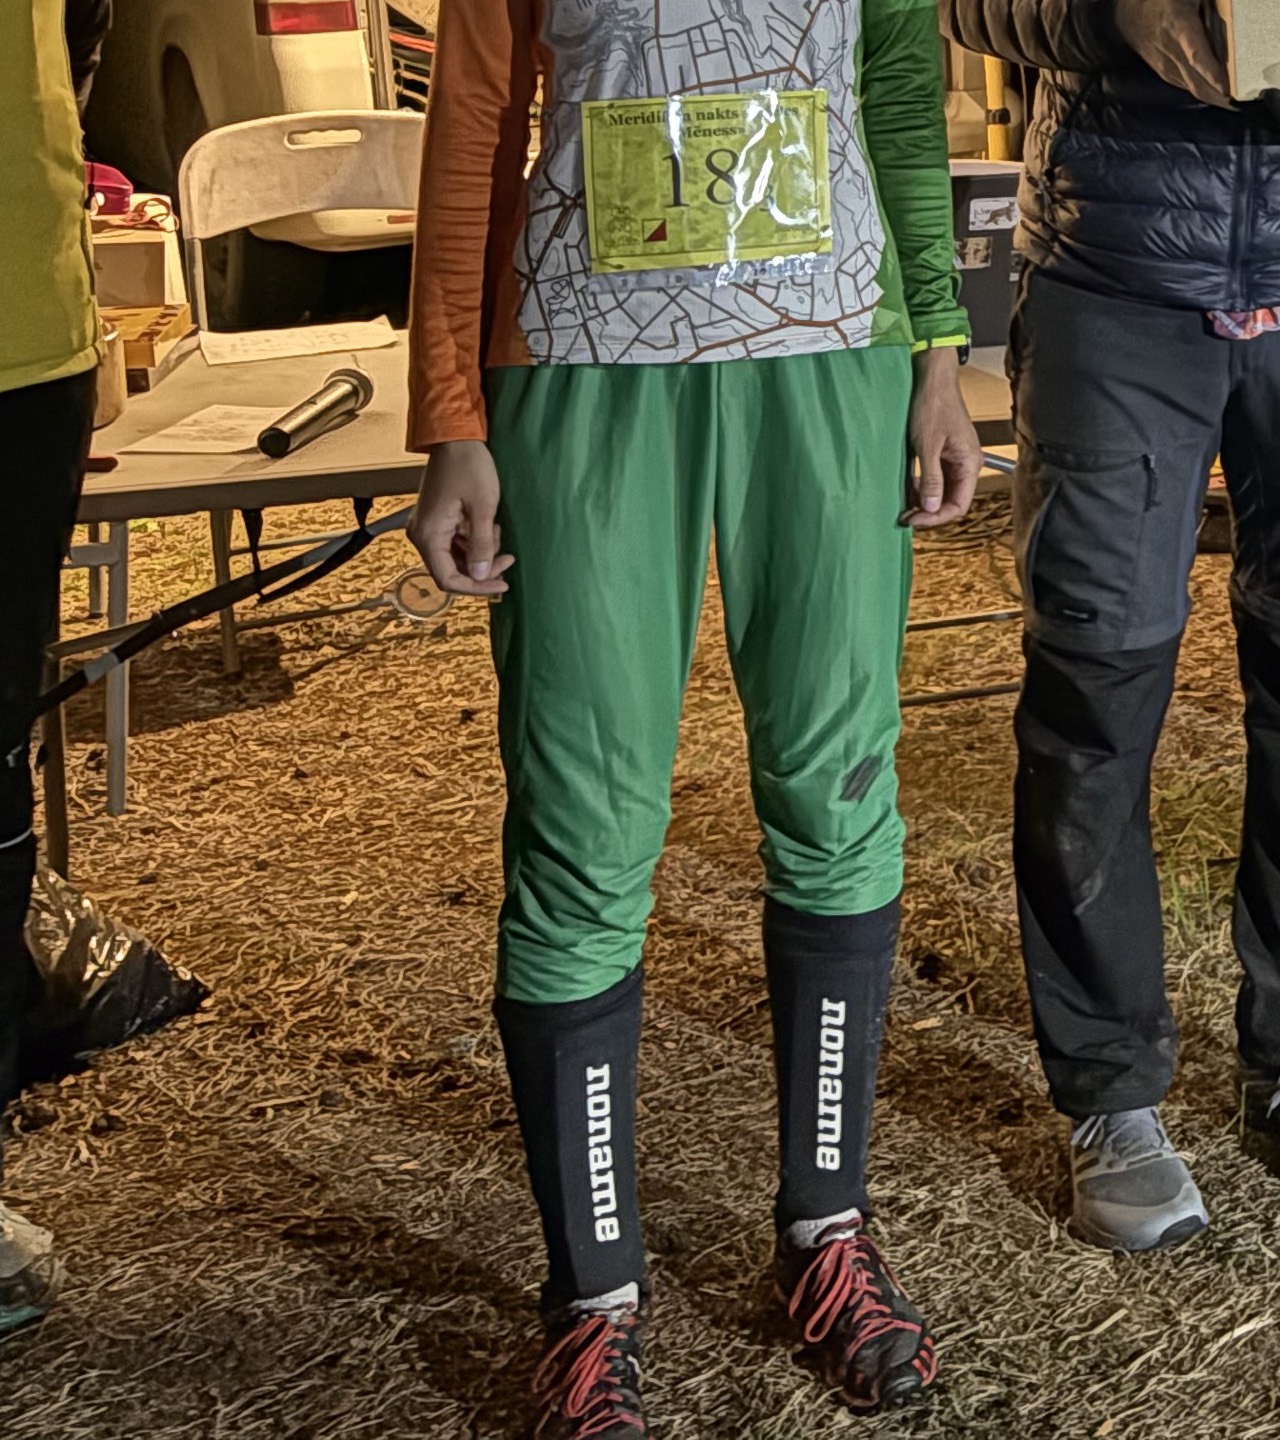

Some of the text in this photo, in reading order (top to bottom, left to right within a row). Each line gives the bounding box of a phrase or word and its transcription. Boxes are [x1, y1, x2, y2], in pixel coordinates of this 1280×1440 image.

[696, 107, 739, 121] nakts
[586, 1063, 620, 1242] noname
[816, 997, 846, 1171] noname
